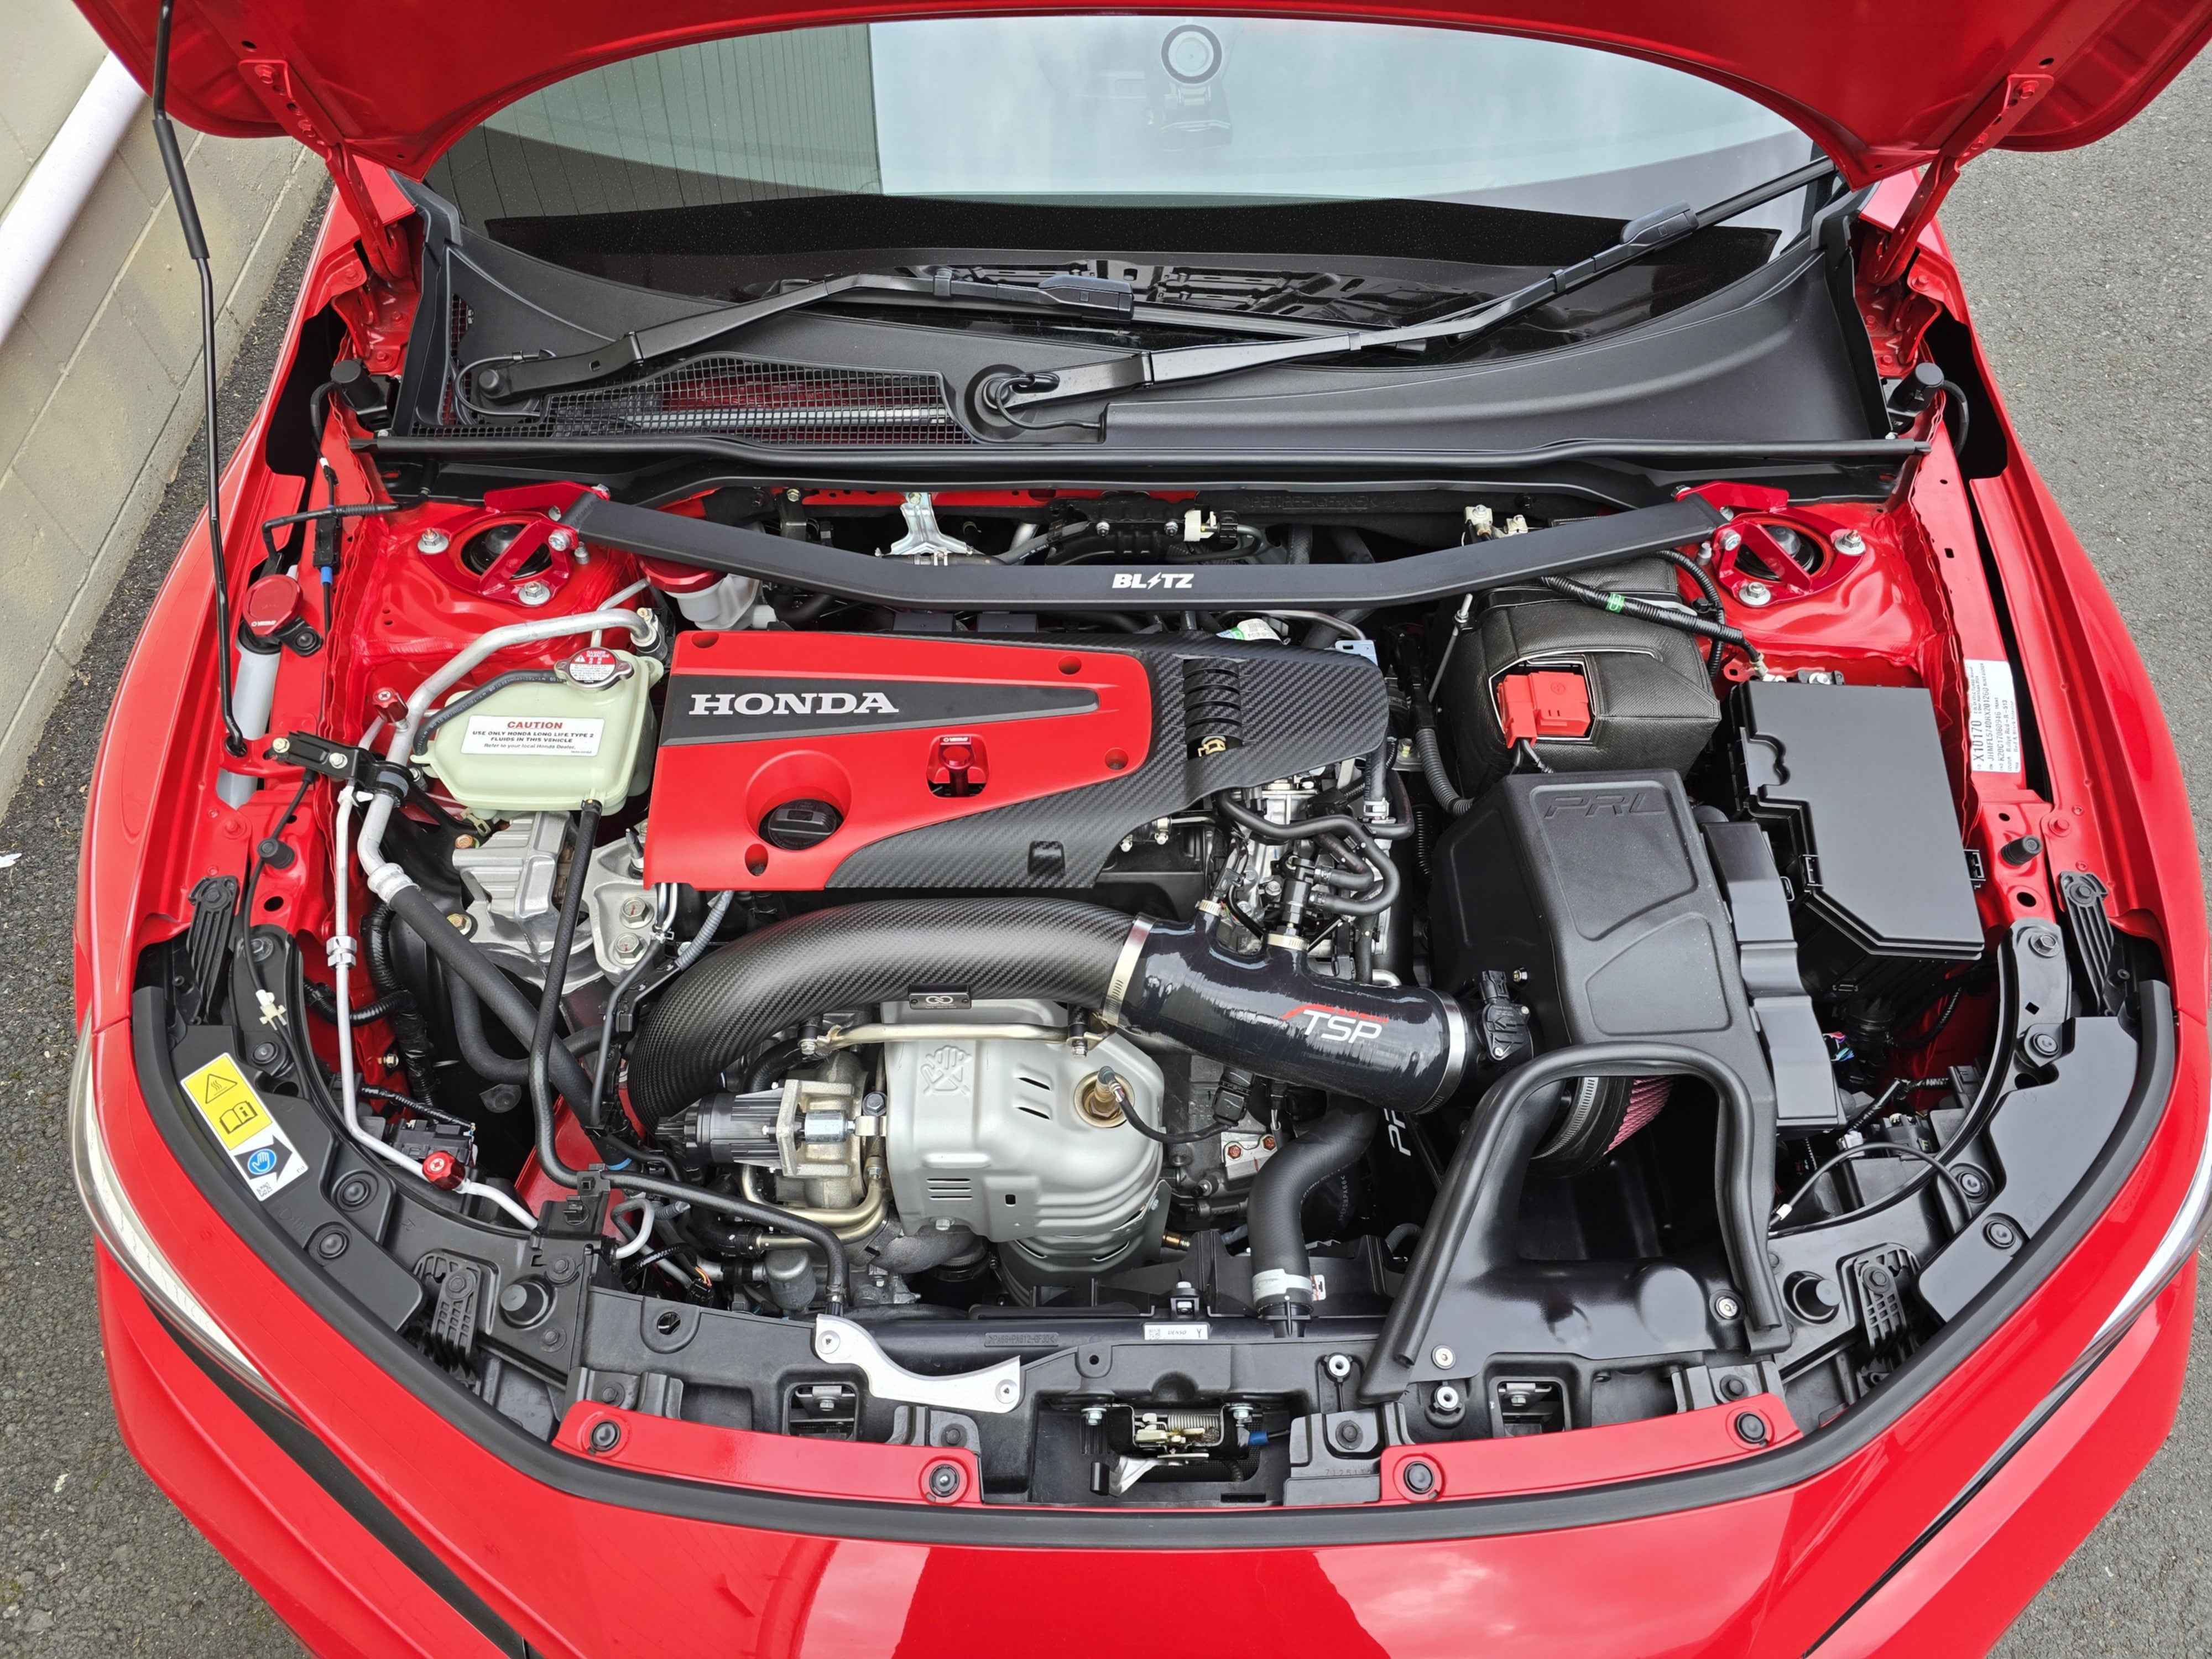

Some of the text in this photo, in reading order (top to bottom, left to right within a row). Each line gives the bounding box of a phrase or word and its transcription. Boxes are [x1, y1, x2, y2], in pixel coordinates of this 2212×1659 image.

[688, 692, 899, 716] HONDA
[1971, 721, 1984, 761] X10170
[1543, 793, 1667, 819] PRL
[1303, 1009, 1383, 1044] TSP
[1196, 1328, 1202, 1338] Y
